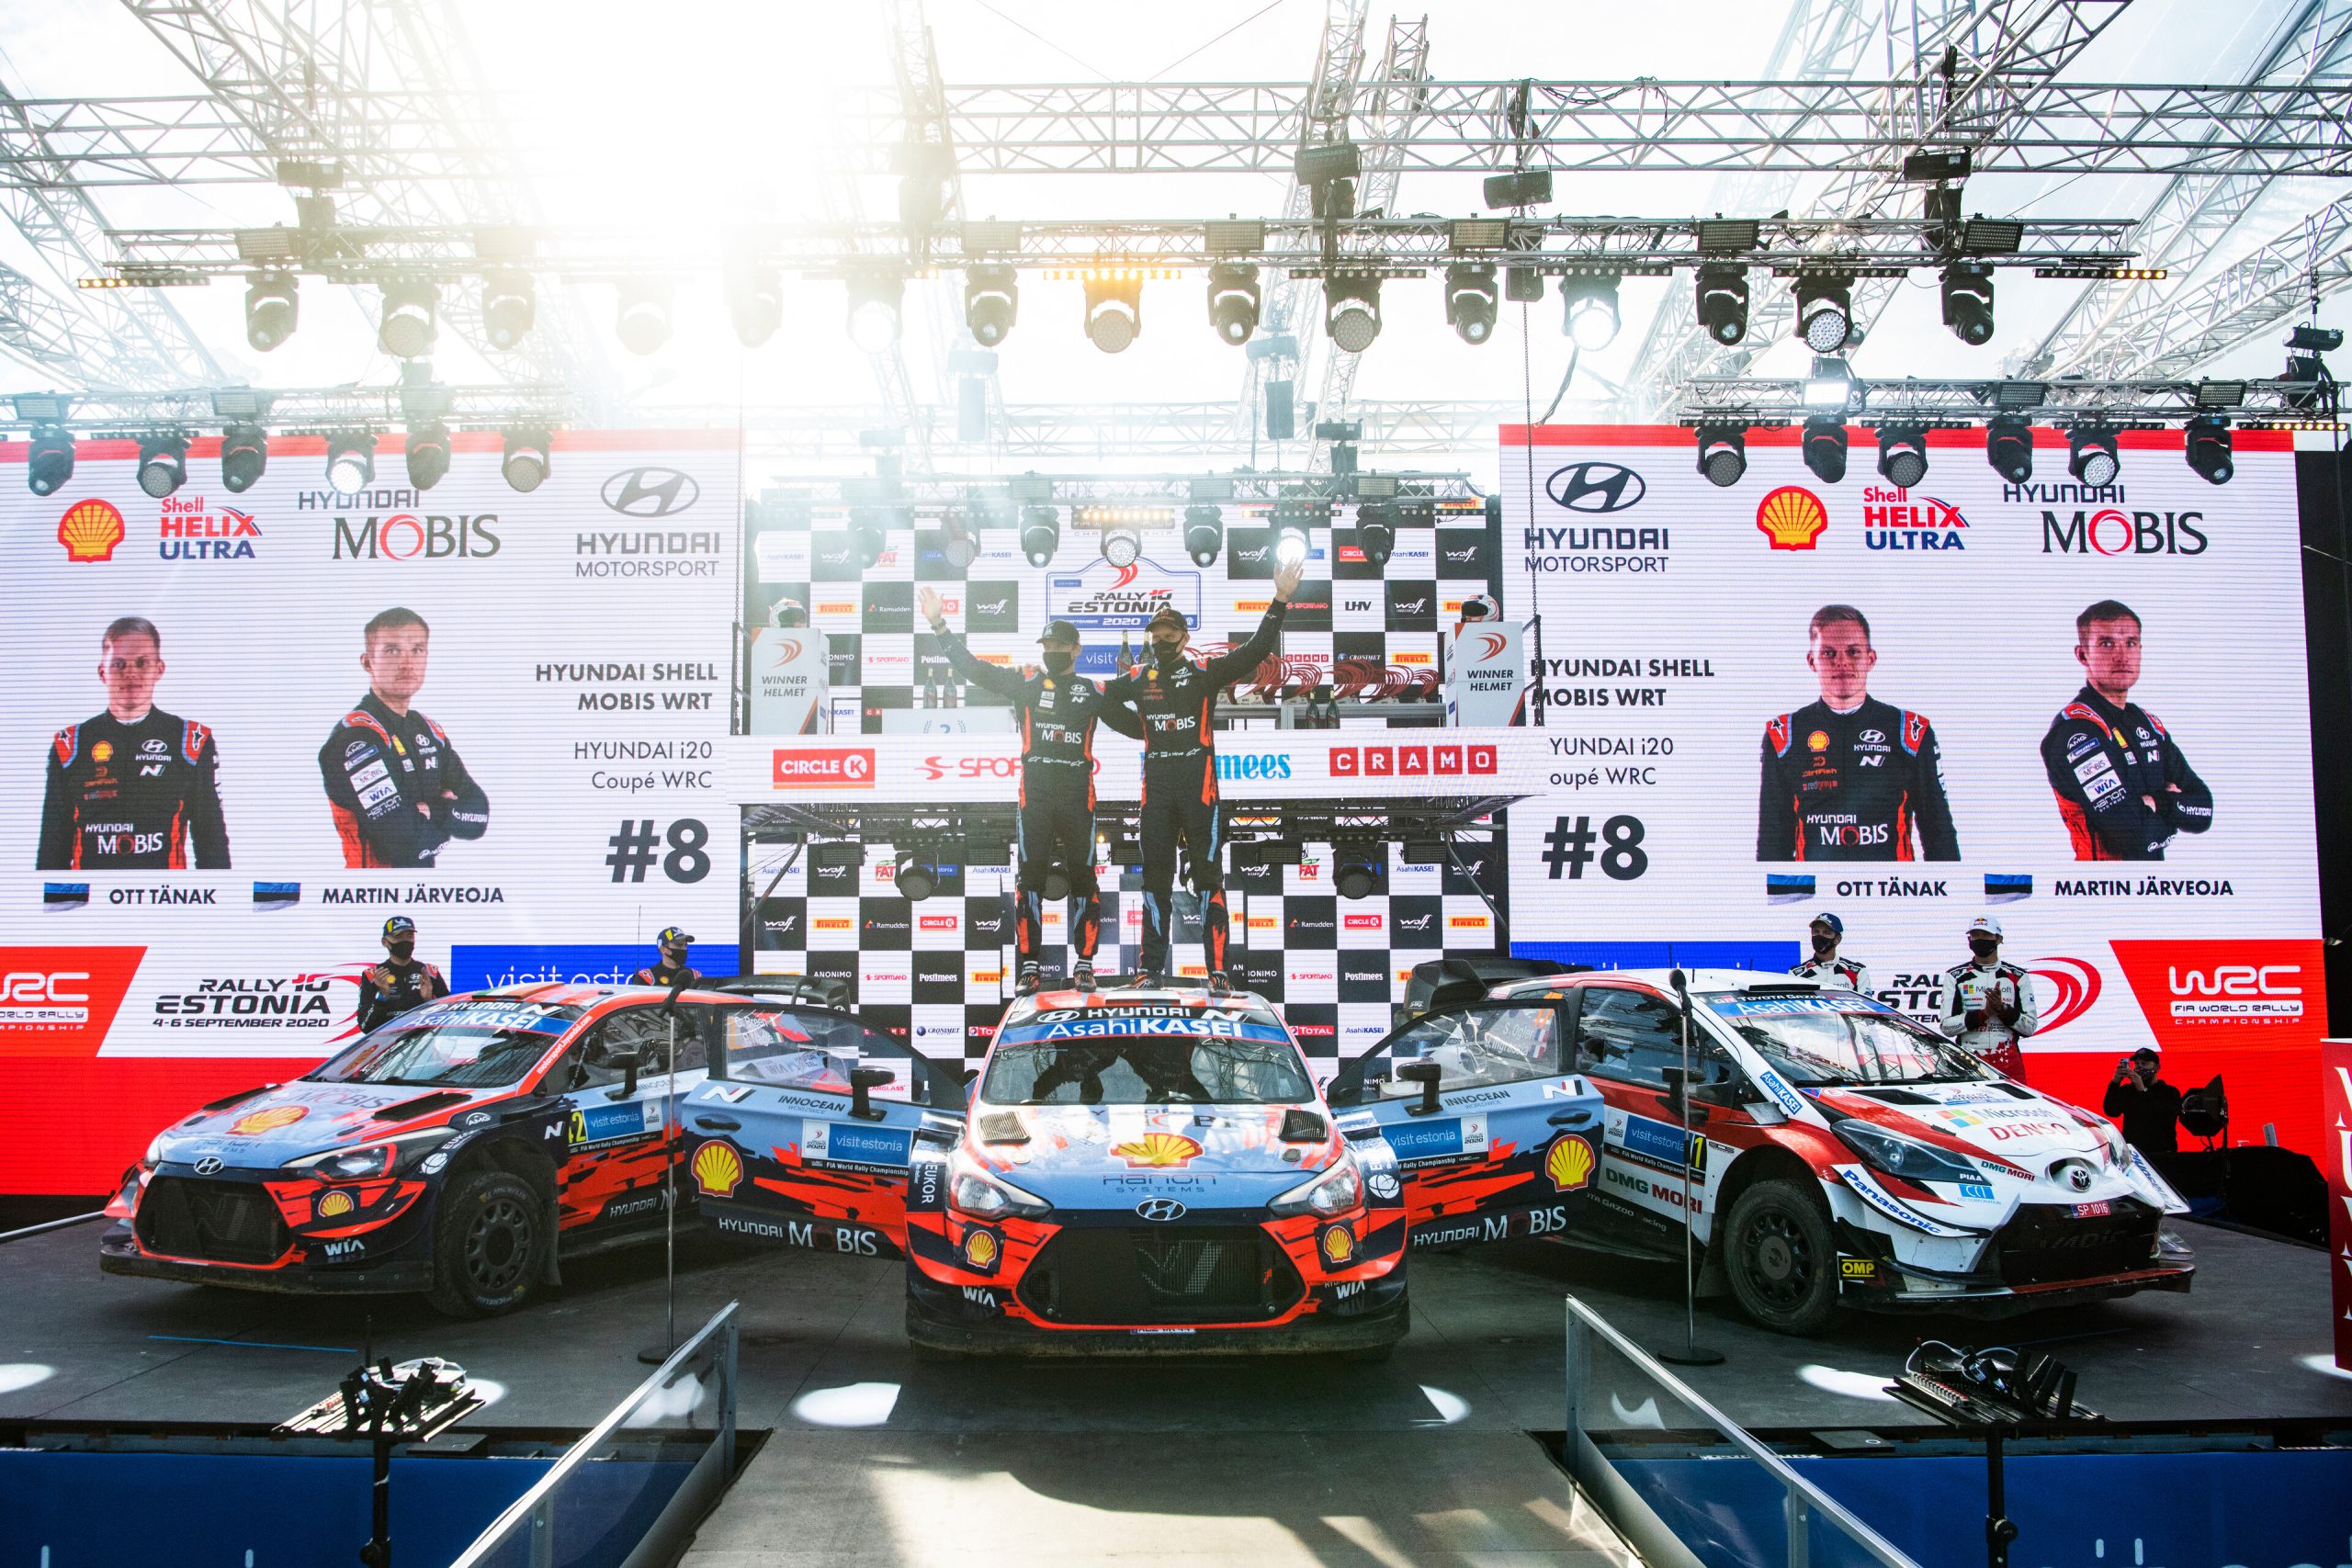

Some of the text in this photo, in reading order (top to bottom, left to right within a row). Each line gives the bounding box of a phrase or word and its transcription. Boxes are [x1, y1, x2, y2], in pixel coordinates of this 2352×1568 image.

[299, 489, 420, 510] HYUNDAI
[1863, 486, 1907, 502] Shell
[2003, 483, 2125, 504] HYUNDAI
[162, 497, 204, 513] Shell
[1864, 500, 1969, 528] HELIX
[160, 511, 262, 538] HELIX
[2040, 509, 2209, 557] MOBIS
[332, 514, 501, 561] MOBIS
[576, 533, 720, 555] HYUNDAI
[1524, 527, 1669, 550] HYUNDAI
[1865, 530, 1965, 550] ULTRA
[159, 540, 256, 559] ULTRA
[1391, 550, 1430, 558] AsahiKASEI
[576, 560, 719, 578] MOTORSPORT
[1525, 556, 1669, 572] MOTORSPORT
[1093, 592, 1148, 601] RALLY
[879, 605, 912, 614] Ramudden
[1068, 602, 1174, 614] ESTONIA
[1344, 601, 1373, 612] LHV
[1102, 617, 1142, 626] 2020
[1085, 653, 1113, 665] visit
[1285, 654, 1329, 662] CRAMO
[1349, 653, 1383, 661] CRONIMET
[536, 663, 718, 682] HYUNDAI SHELL
[1466, 669, 1514, 680] WINNER
[1531, 659, 1715, 677] HYUNDAI SHELL
[761, 675, 808, 685] WINNER
[1469, 682, 1513, 692] HELMET
[577, 693, 712, 711] MOBIS WRT
[763, 688, 807, 698] HELMET
[1531, 688, 1667, 706] MOBIS WRT
[1035, 722, 1066, 730] HYUNDAI
[1155, 716, 1196, 732] MOBIS
[1041, 729, 1082, 745] MOBIS
[574, 741, 713, 760] HYUNDAI i20
[1549, 737, 1674, 756] YUNDAI i20
[1853, 744, 1891, 752] HYUNDAI
[135, 754, 172, 762] HYUNDAI
[1332, 747, 1494, 773] CRAMO
[780, 760, 841, 775] CIRCLE
[592, 770, 713, 794] Coupé WRC
[1550, 767, 1657, 791] oupé WRC
[85, 823, 134, 833] HYUNDAI
[1806, 814, 1857, 825] HYUNDAI
[97, 832, 164, 855] MOBIS
[1820, 823, 1889, 846] MOBIS
[605, 818, 712, 884] #8
[1541, 814, 1648, 881] #8
[1299, 864, 1319, 877] FAT
[1396, 864, 1434, 873] AsahiKASEI
[109, 885, 217, 905] OTT TÄNAK
[322, 884, 504, 904] MARTIN JÄRVEOJA
[1837, 875, 1948, 897] OTT TÄNAK
[2054, 875, 2234, 897] MARTIN JÄRVEOJA
[876, 921, 910, 930] Ramudden
[198, 978, 288, 993] RALLY
[919, 973, 958, 983] Postimees
[1344, 971, 1384, 982] Postimees
[2168, 965, 2302, 996] WRC
[0, 972, 90, 1002] RC
[155, 994, 332, 1015] ESTONIA
[449, 1001, 521, 1011] HYUNDAI
[1087, 1007, 1191, 1018] HYUNDAI
[1736, 999, 1877, 1016] AsahiKASEI
[38, 1010, 85, 1019] RALLY
[153, 1017, 331, 1028] 4-6 SEPTEMBER 2020
[406, 1010, 542, 1031] AsahiKASEI
[1046, 1018, 1243, 1040] AsahiKASEI
[1298, 1026, 1334, 1035] TOTAL
[1345, 1026, 1385, 1034] AsahiKASEI
[536, 1014, 593, 1076] motorsport.hyundai.com
[1443, 1089, 1511, 1107] INNOCEAN
[1761, 1072, 1801, 1114] AsahiKASEI
[777, 1095, 846, 1111] INNOCEAN
[590, 1111, 640, 1128] visit estonia
[1972, 1107, 2062, 1121] Microsoft
[1390, 1129, 1456, 1147] visit estonia
[1631, 1128, 1685, 1152] visit estonia
[1987, 1122, 2071, 1141] DENSO
[835, 1134, 903, 1152] visit estonia
[1403, 1156, 1456, 1170] Rally Championship
[1630, 1153, 1644, 1162] World
[854, 1165, 869, 1173] Rally
[869, 1166, 909, 1176] Championship
[1959, 1173, 1983, 1182] PIAA
[1981, 1161, 2036, 1182] DMG MORI
[922, 1163, 938, 1205] EUKOR
[1605, 1167, 1702, 1215] DMG MORI
[610, 1197, 658, 1218] HYUNDAI
[1601, 1198, 1634, 1217] GAZOO
[1842, 1168, 1942, 1235] Panasonic
[2077, 1202, 2109, 1217] SP 1016
[1413, 1205, 1567, 1247] HYUNDAI MOBIS
[718, 1216, 878, 1257] HYUNDAI MOBIS
[324, 1239, 366, 1258] WIA
[1841, 1262, 1875, 1276] OMP
[962, 1284, 997, 1308] WIA
[1336, 1280, 1366, 1300] WIA
